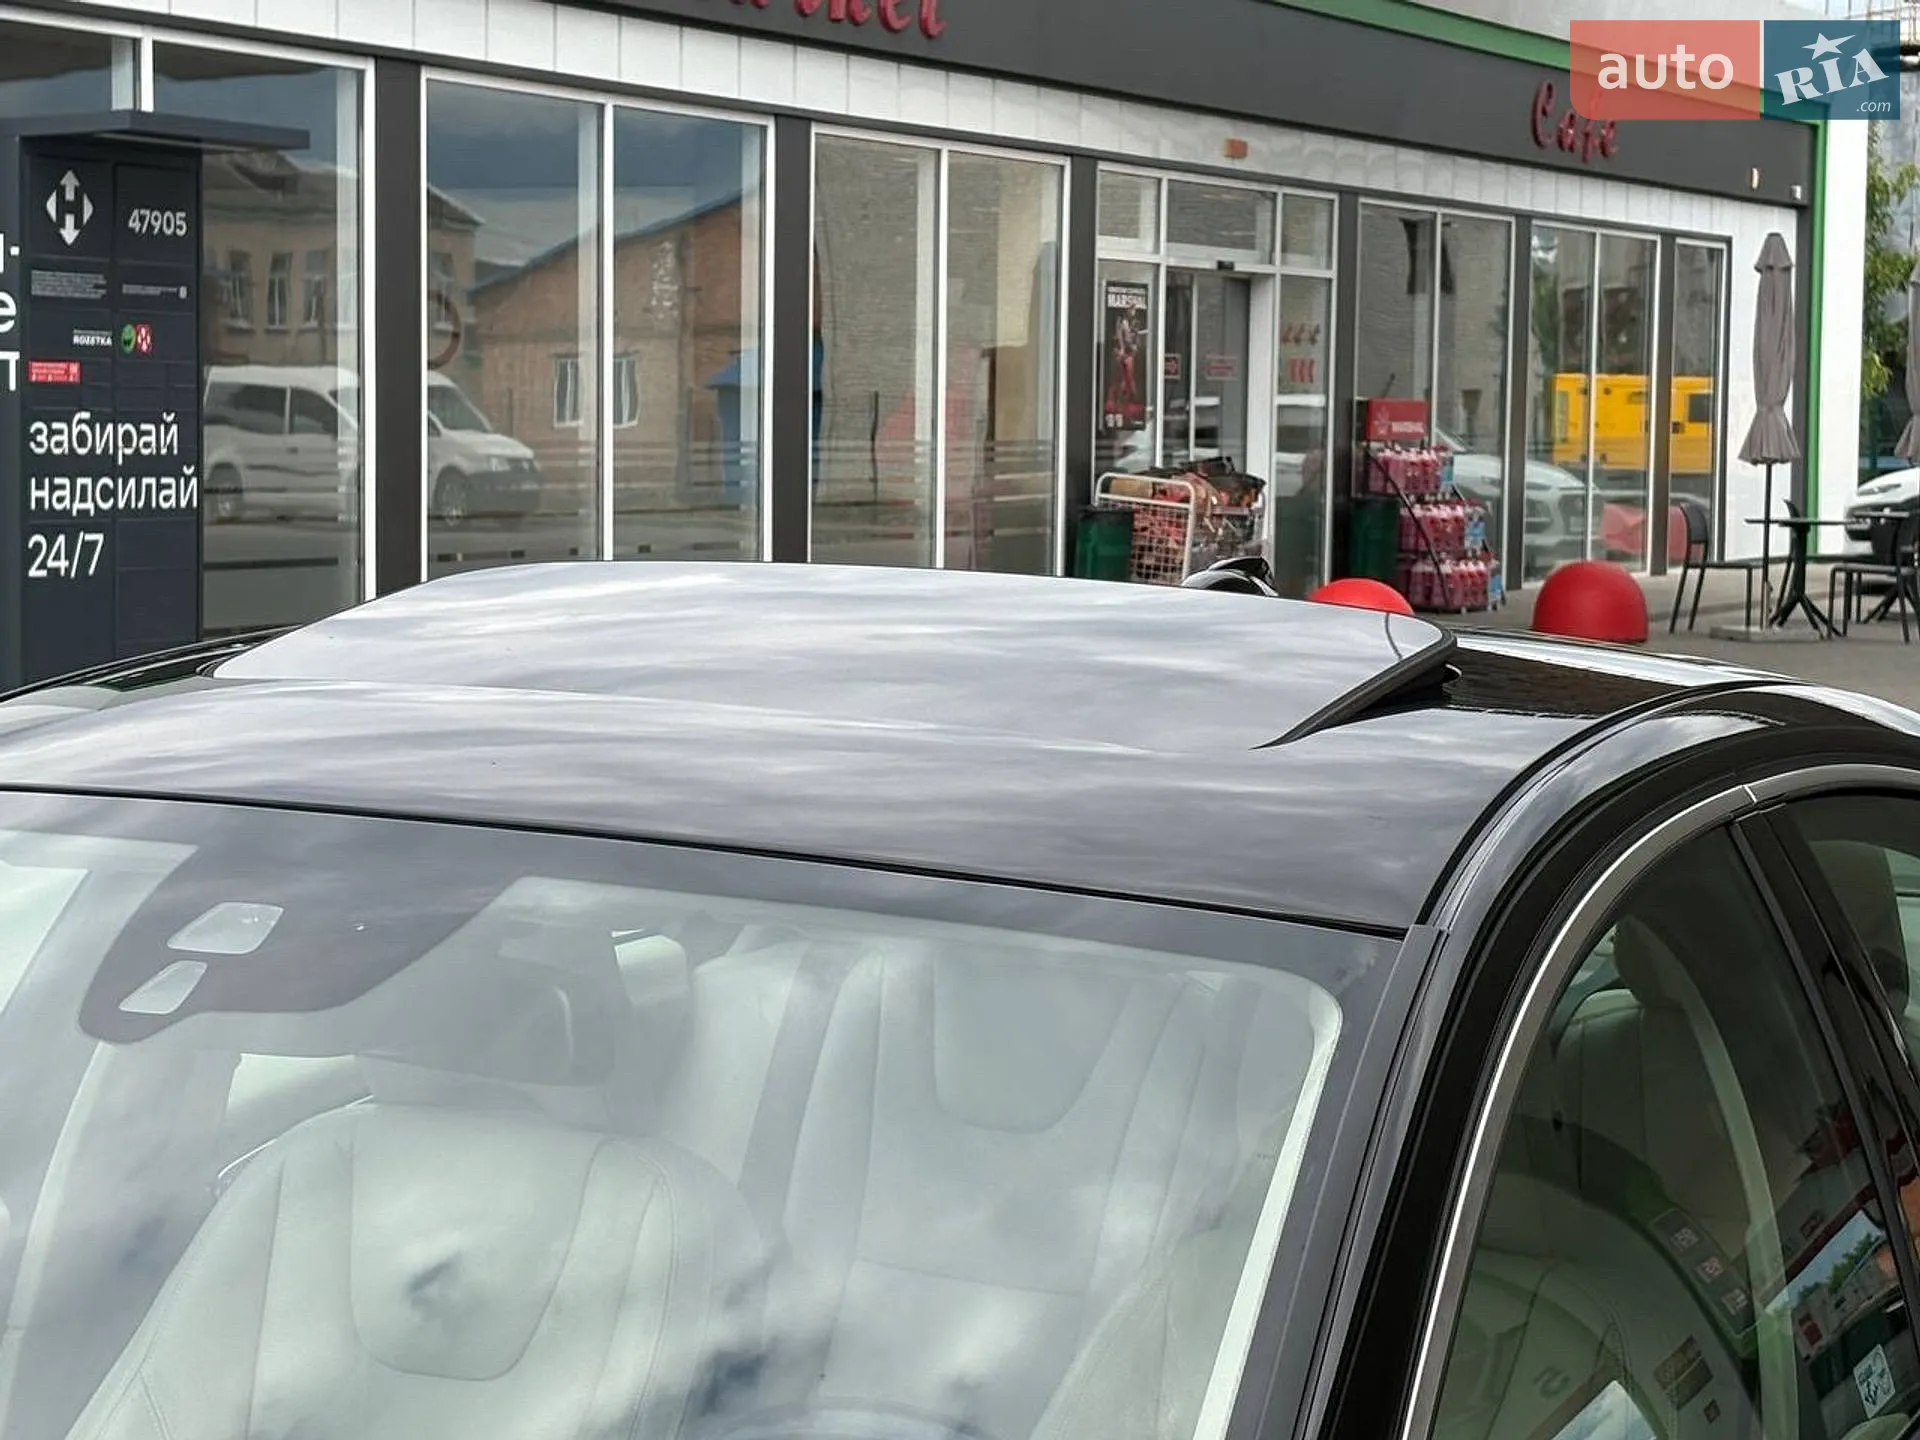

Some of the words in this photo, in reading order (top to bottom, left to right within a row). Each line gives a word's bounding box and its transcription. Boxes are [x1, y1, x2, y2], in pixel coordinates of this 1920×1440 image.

[128, 208, 188, 237] 47905
[29, 411, 179, 466] забирай
[30, 464, 198, 517] надсилай
[27, 531, 104, 578] 24/7
